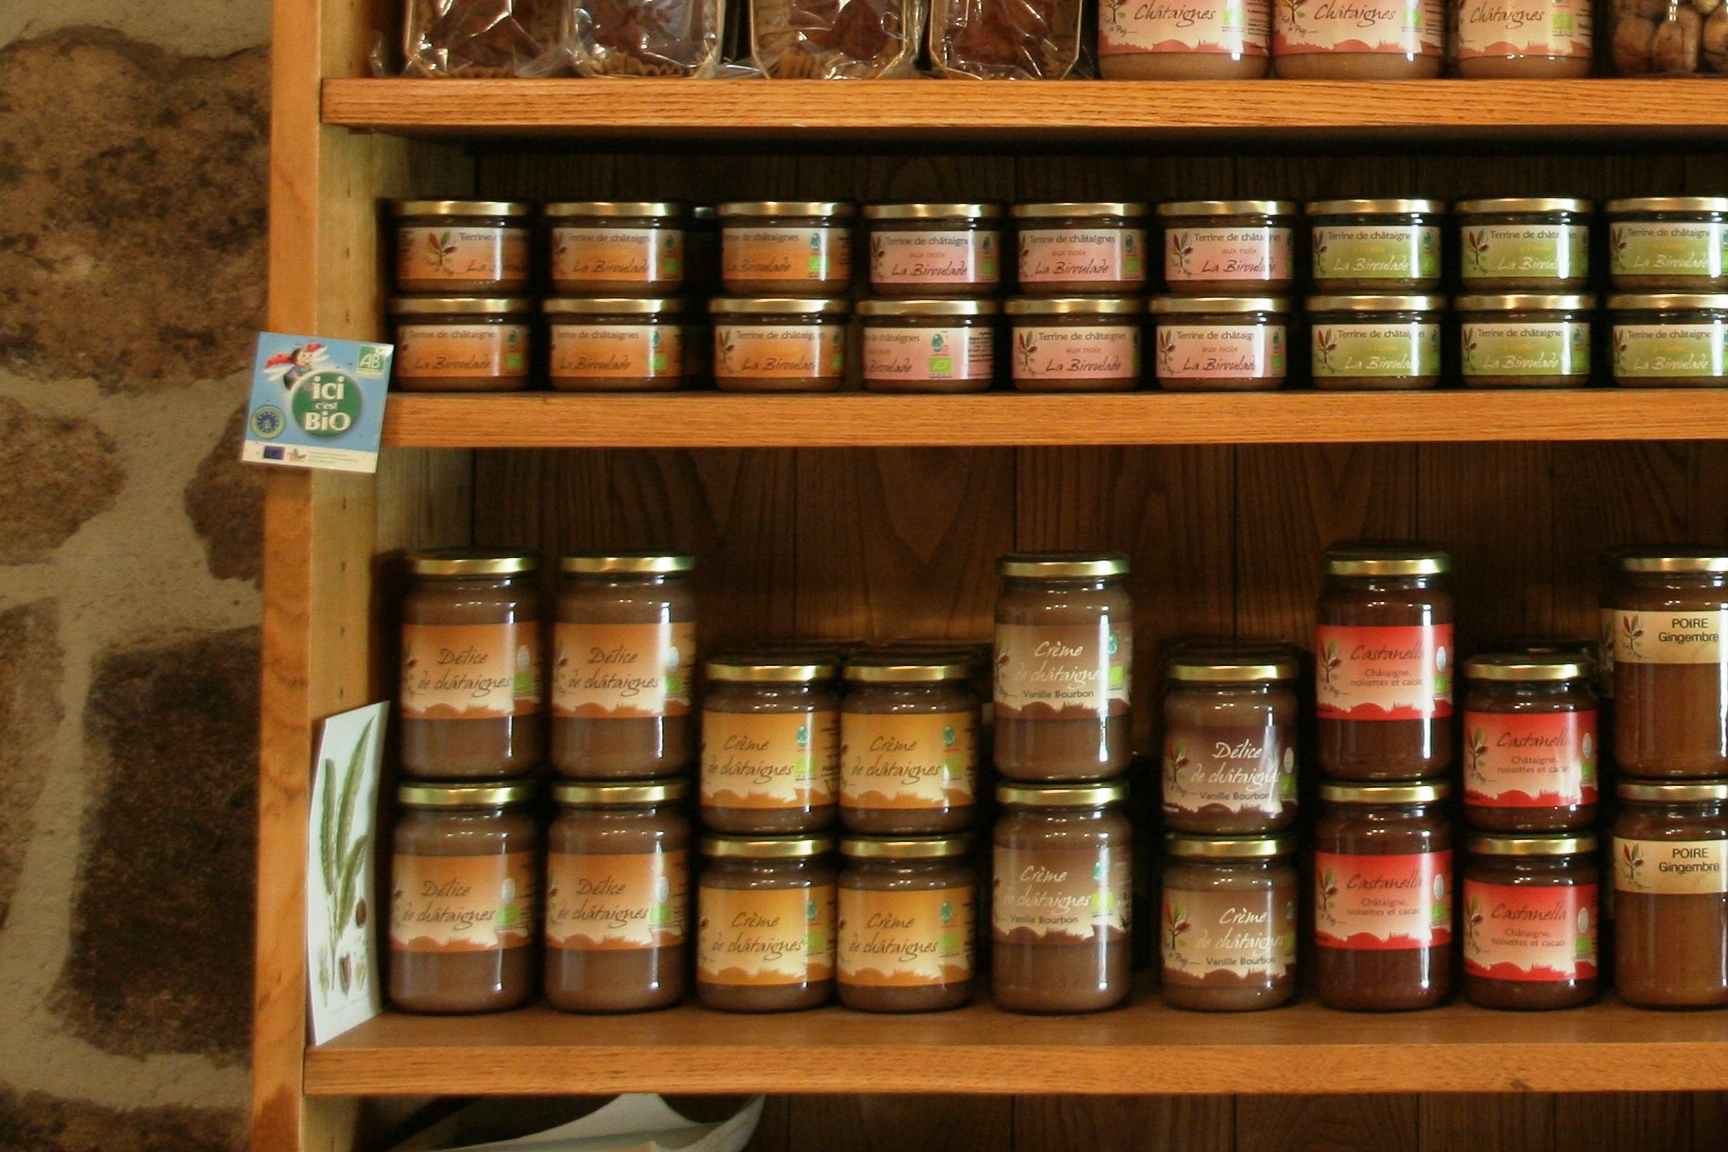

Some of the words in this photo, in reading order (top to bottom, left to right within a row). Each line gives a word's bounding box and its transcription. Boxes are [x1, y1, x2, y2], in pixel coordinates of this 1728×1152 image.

[1134, 0, 1216, 28] Châtaignes
[1314, 0, 1397, 28] Châtaignes
[1470, 1, 1545, 30] Châtaignes
[885, 236, 913, 246] Terrine
[1069, 233, 1116, 246] châtaignes
[1194, 232, 1225, 242] Terrine
[1490, 230, 1519, 239] Terrine
[892, 263, 908, 276] La
[914, 262, 967, 277] Biroulade
[1035, 261, 1049, 274] La
[1052, 259, 1109, 274] Biroulade
[1202, 260, 1219, 273] La
[1353, 257, 1409, 272] Biroulade
[359, 353, 381, 369] AB
[1066, 358, 1122, 373] Biroulade
[1504, 353, 1560, 369] Biroulade
[311, 375, 345, 400] ici
[315, 402, 338, 410] c'est
[1671, 617, 1709, 629] POIRE
[1658, 631, 1720, 644] Gingembre
[437, 649, 488, 666] Délice
[587, 648, 640, 666] Délice
[432, 667, 510, 697] châtaignes
[584, 667, 661, 697] châtaignes
[1350, 678, 1388, 688] noisettes
[1390, 679, 1400, 687] et
[1023, 689, 1053, 698] Vanille
[1055, 689, 1094, 699] Bourbon
[723, 736, 770, 751] Crème
[870, 736, 917, 751] Crème
[720, 755, 794, 784] châtaignes
[867, 756, 939, 784] châtaignes
[1497, 765, 1535, 774] noisettes
[1537, 765, 1547, 774] et
[1200, 791, 1231, 800] Vanille
[1233, 791, 1271, 802] Bourbon
[1672, 847, 1709, 859] POIRE
[1659, 861, 1720, 874] Gingembre
[416, 898, 495, 929] châtaignes
[572, 898, 649, 928] châtaignes
[731, 912, 780, 928] Crème
[1040, 915, 1079, 925] Bourbon
[727, 932, 801, 960] châtaignes
[863, 932, 938, 961] châtaignes
[1530, 939, 1540, 947] et
